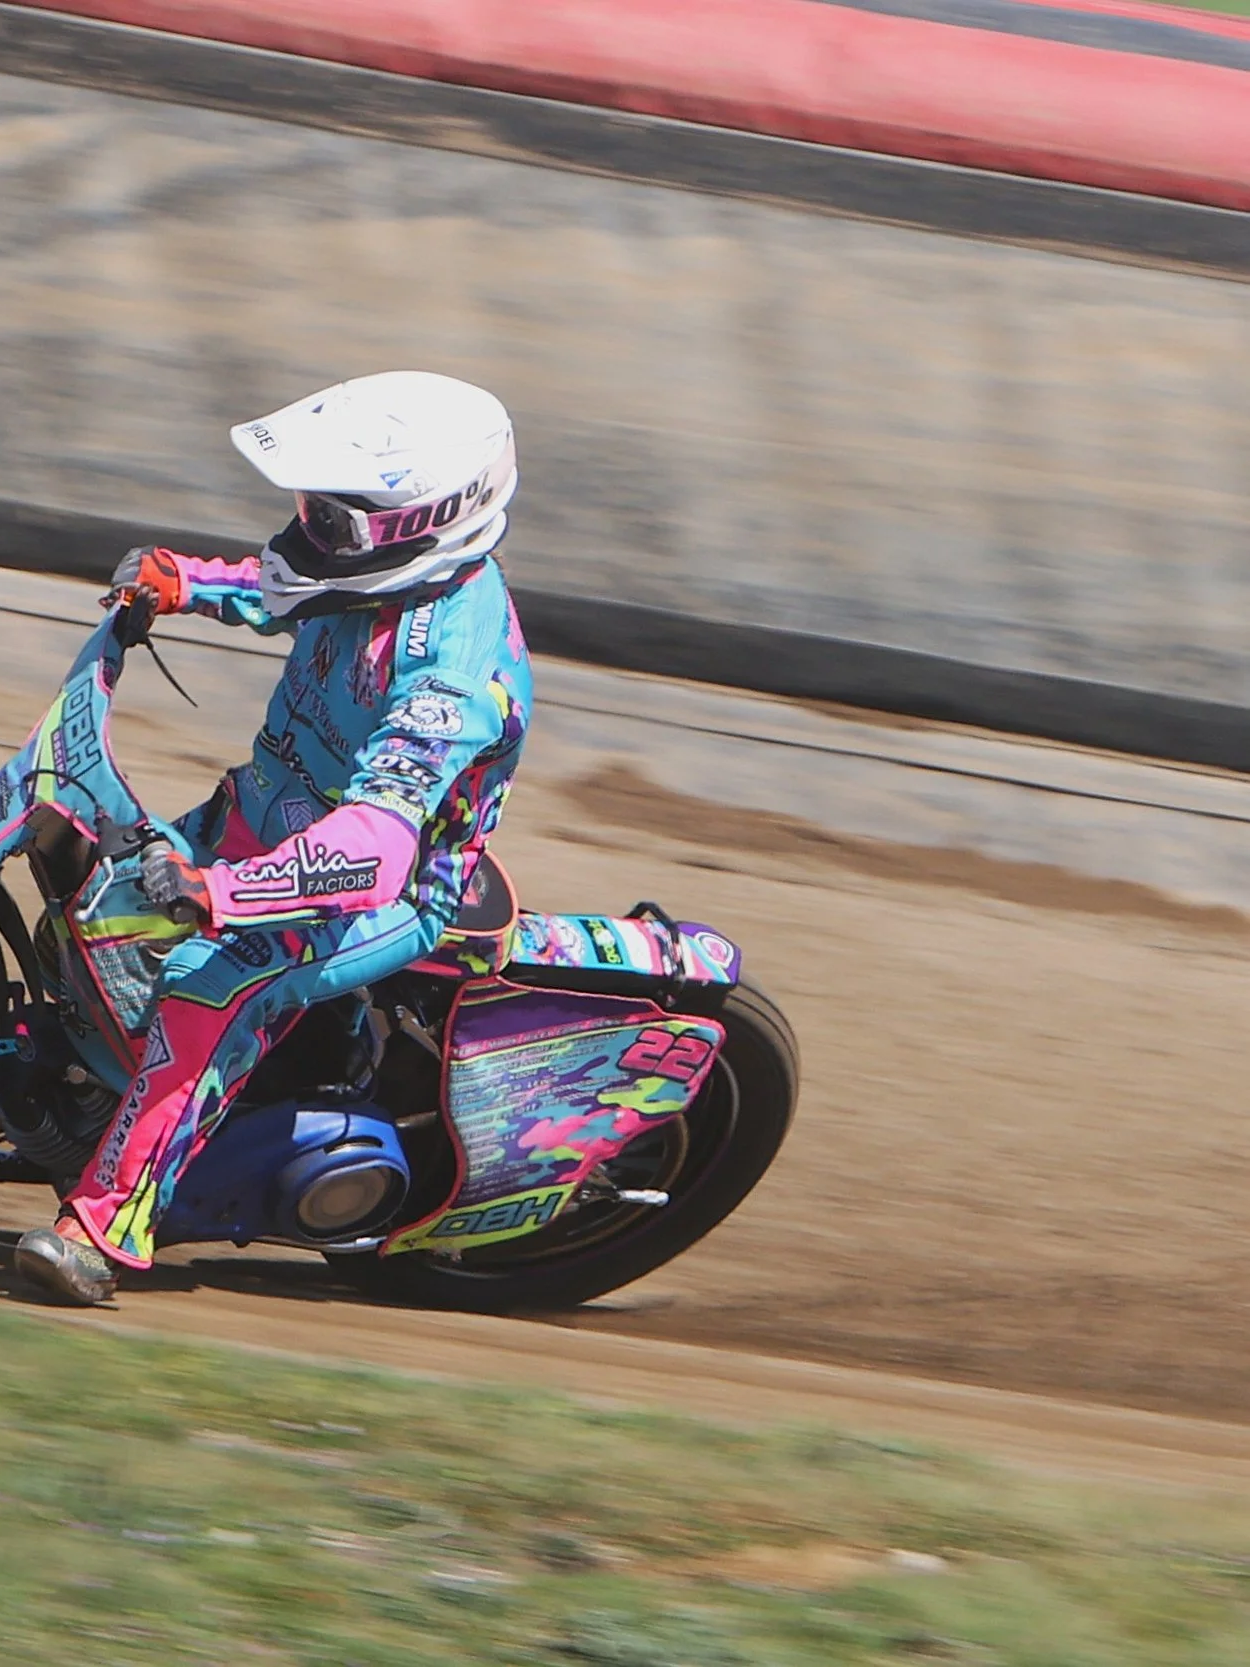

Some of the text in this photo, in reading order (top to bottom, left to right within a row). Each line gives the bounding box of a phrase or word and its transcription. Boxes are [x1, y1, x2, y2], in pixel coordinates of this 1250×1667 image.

[377, 472, 493, 543] 100%
[62, 678, 102, 779] DBH
[234, 837, 380, 901] anglia
[306, 871, 376, 896] FACTORS
[618, 1027, 713, 1083] 22
[100, 1074, 148, 1190] GARRICK
[431, 1191, 564, 1238] DBH
